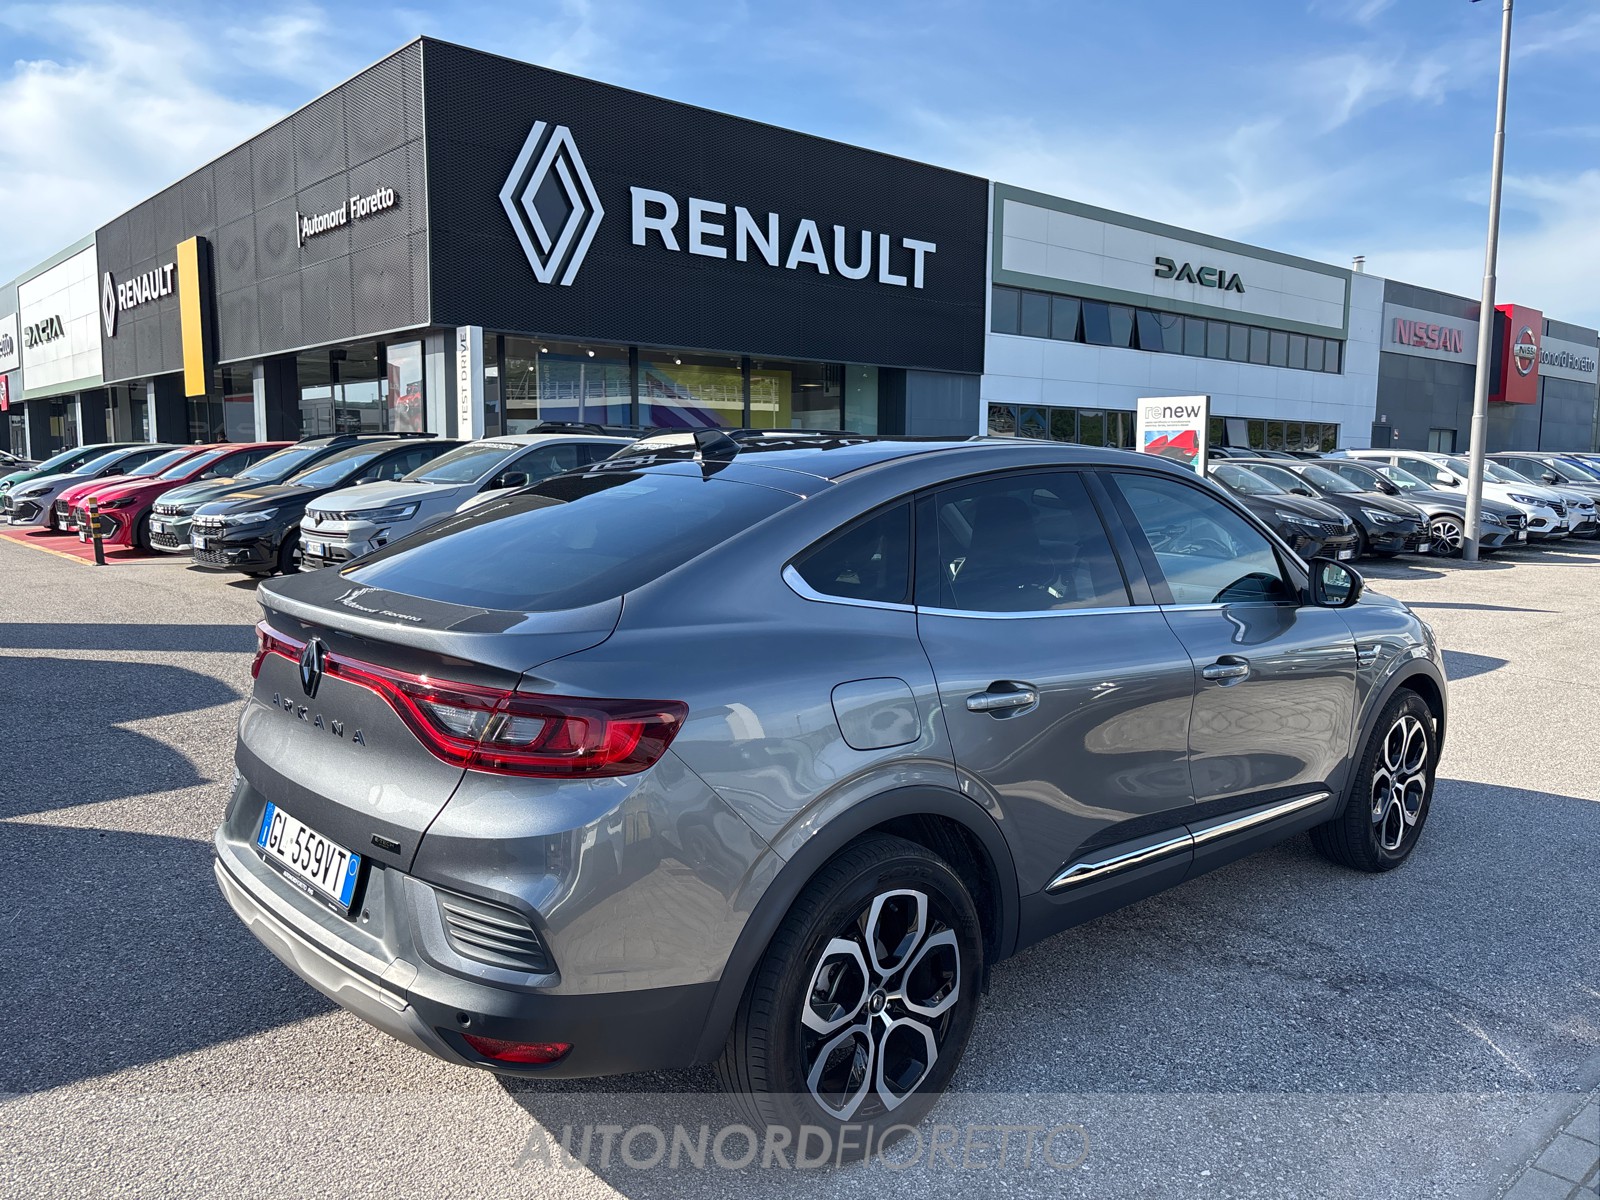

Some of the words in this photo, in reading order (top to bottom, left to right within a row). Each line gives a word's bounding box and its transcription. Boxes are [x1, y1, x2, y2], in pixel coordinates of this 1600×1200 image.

[302, 201, 347, 238] Autonord
[350, 186, 394, 219] Fioretto
[629, 186, 937, 289] RENAULT
[117, 262, 174, 311] RENAULT
[1154, 256, 1245, 293] DACIA
[24, 314, 65, 349] DACIA
[1393, 317, 1463, 353] NISSAN
[1568, 352, 1595, 372] Fioretto
[1145, 405, 1201, 419] renew
[272, 692, 366, 747] ARKANA
[269, 811, 287, 857] GL
[291, 826, 347, 892] 559VT
